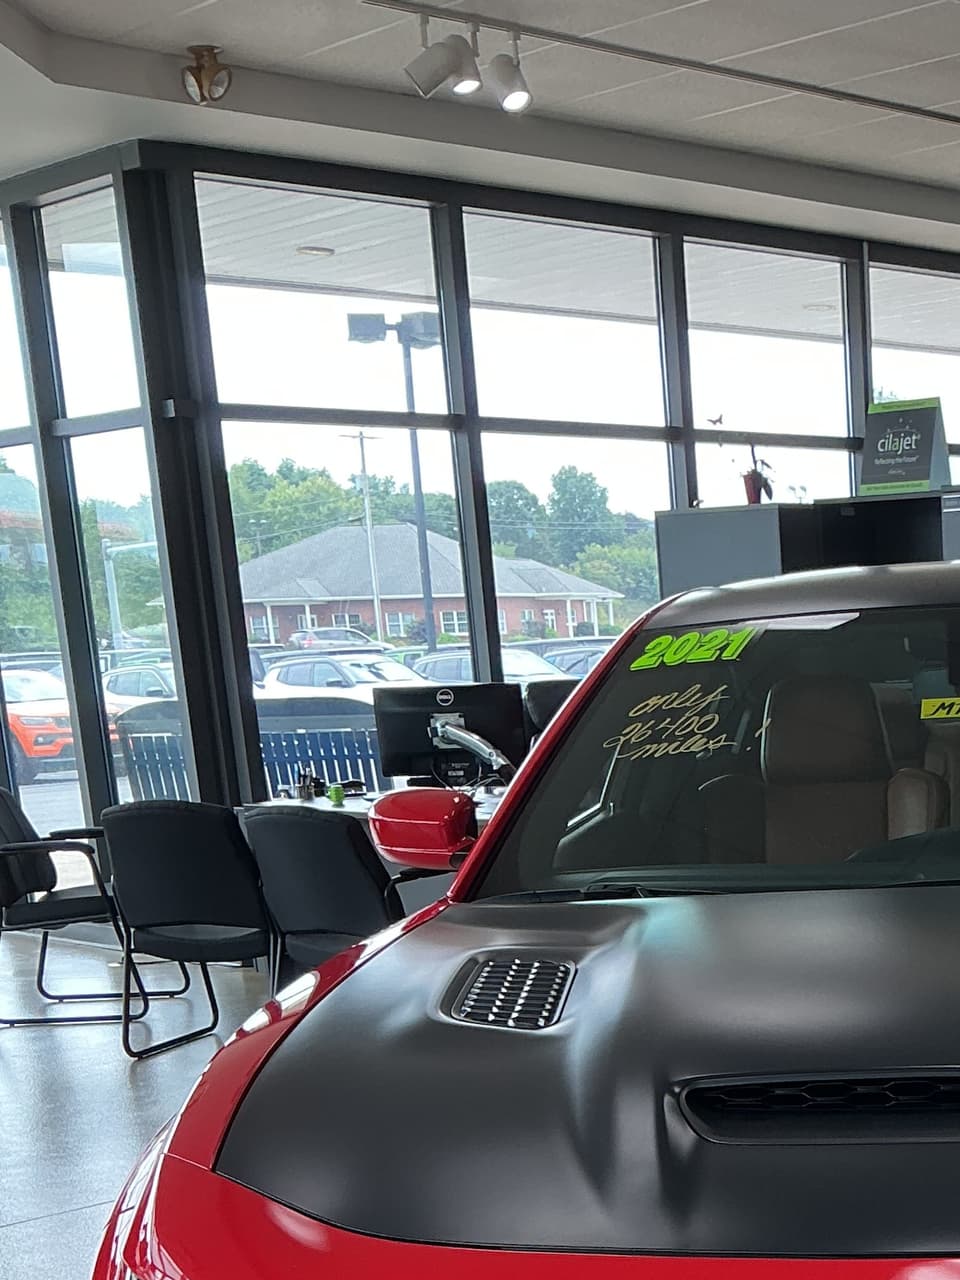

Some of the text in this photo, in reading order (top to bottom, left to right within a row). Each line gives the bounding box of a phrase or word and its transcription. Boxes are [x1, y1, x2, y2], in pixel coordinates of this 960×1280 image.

[877, 433, 917, 454] cilajet
[630, 627, 758, 671] 2021
[629, 684, 730, 718] only
